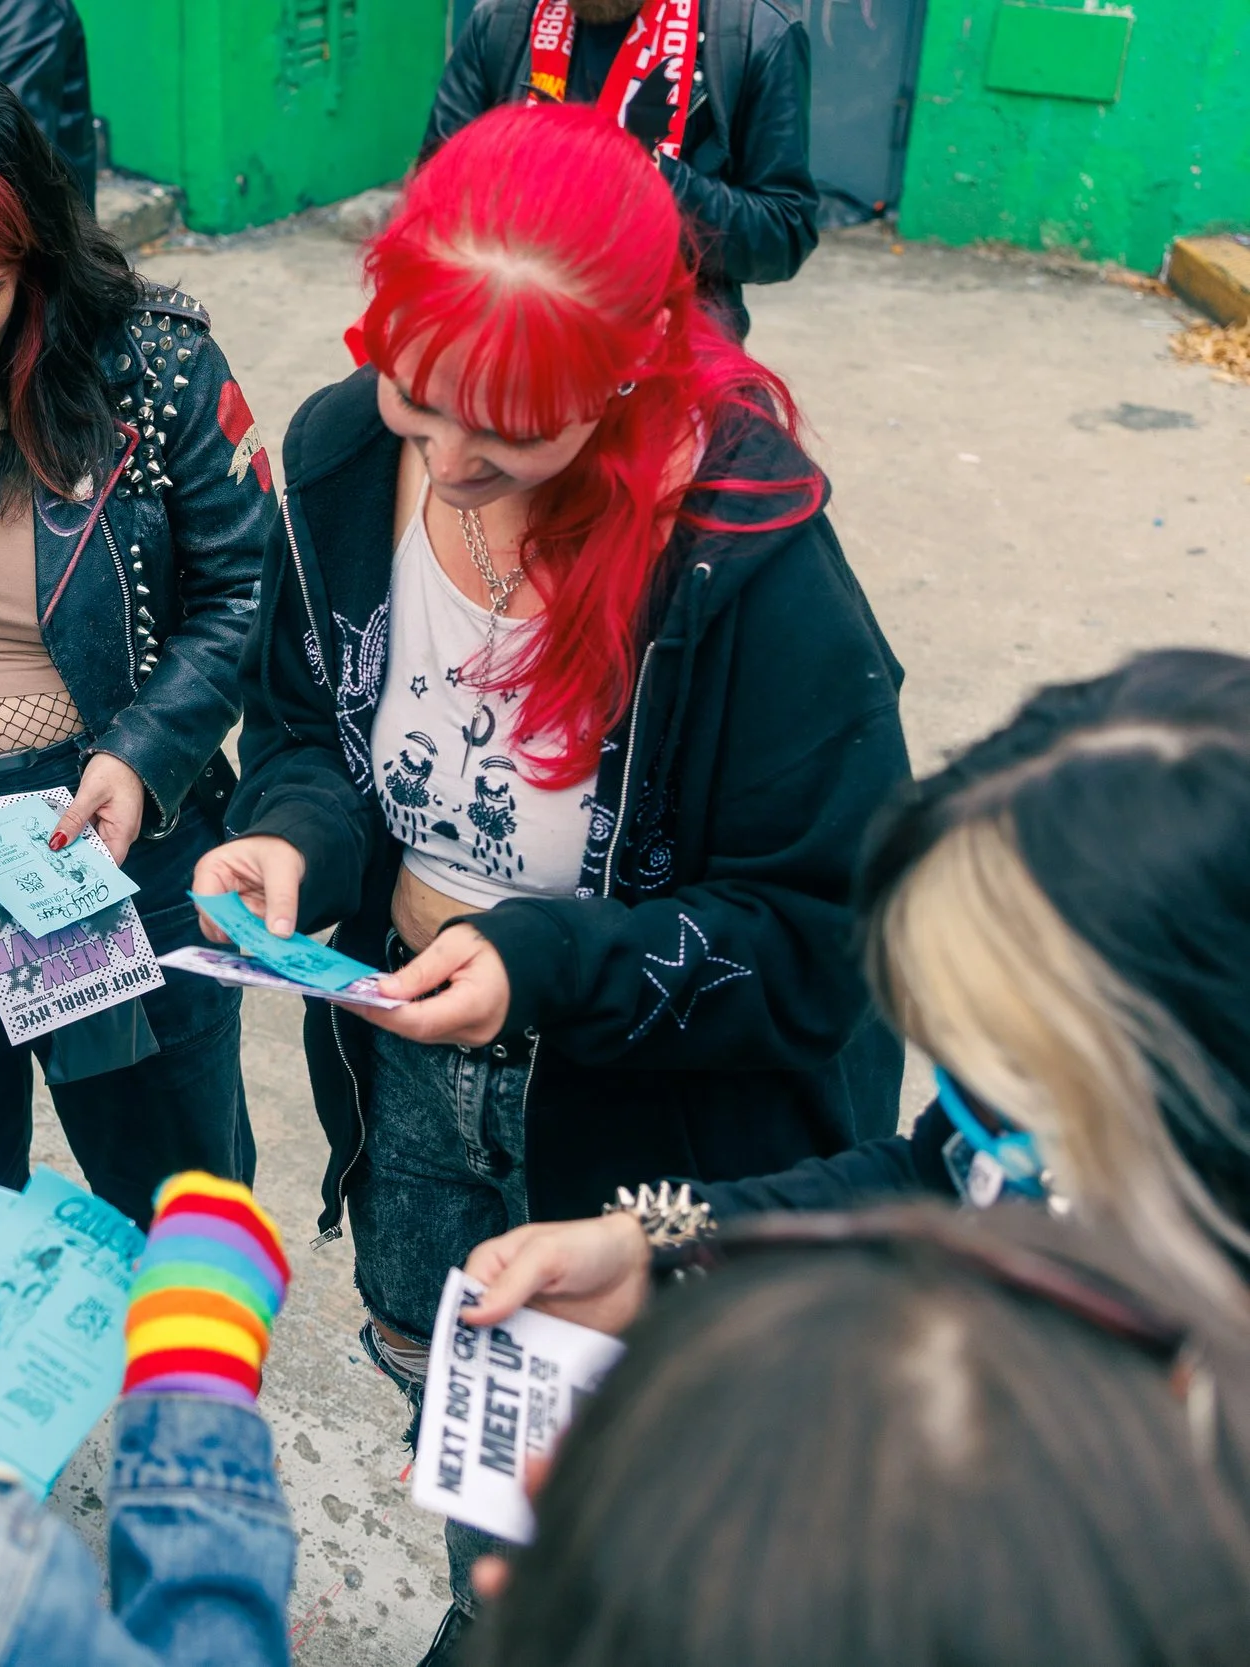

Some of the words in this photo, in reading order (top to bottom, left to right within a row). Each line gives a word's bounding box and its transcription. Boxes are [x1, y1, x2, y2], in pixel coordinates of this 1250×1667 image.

[15, 871, 37, 884] GAY
[26, 883, 44, 894] BIG
[110, 927, 136, 958] A
[41, 939, 110, 990] NEW
[112, 964, 150, 990] RIOT
[57, 981, 108, 1014] GRRRL
[16, 1004, 51, 1029] NYC
[489, 1327, 524, 1370] UP
[446, 1365, 473, 1421] RIOT
[480, 1376, 520, 1476] MEET
[437, 1426, 466, 1494] NEXT
